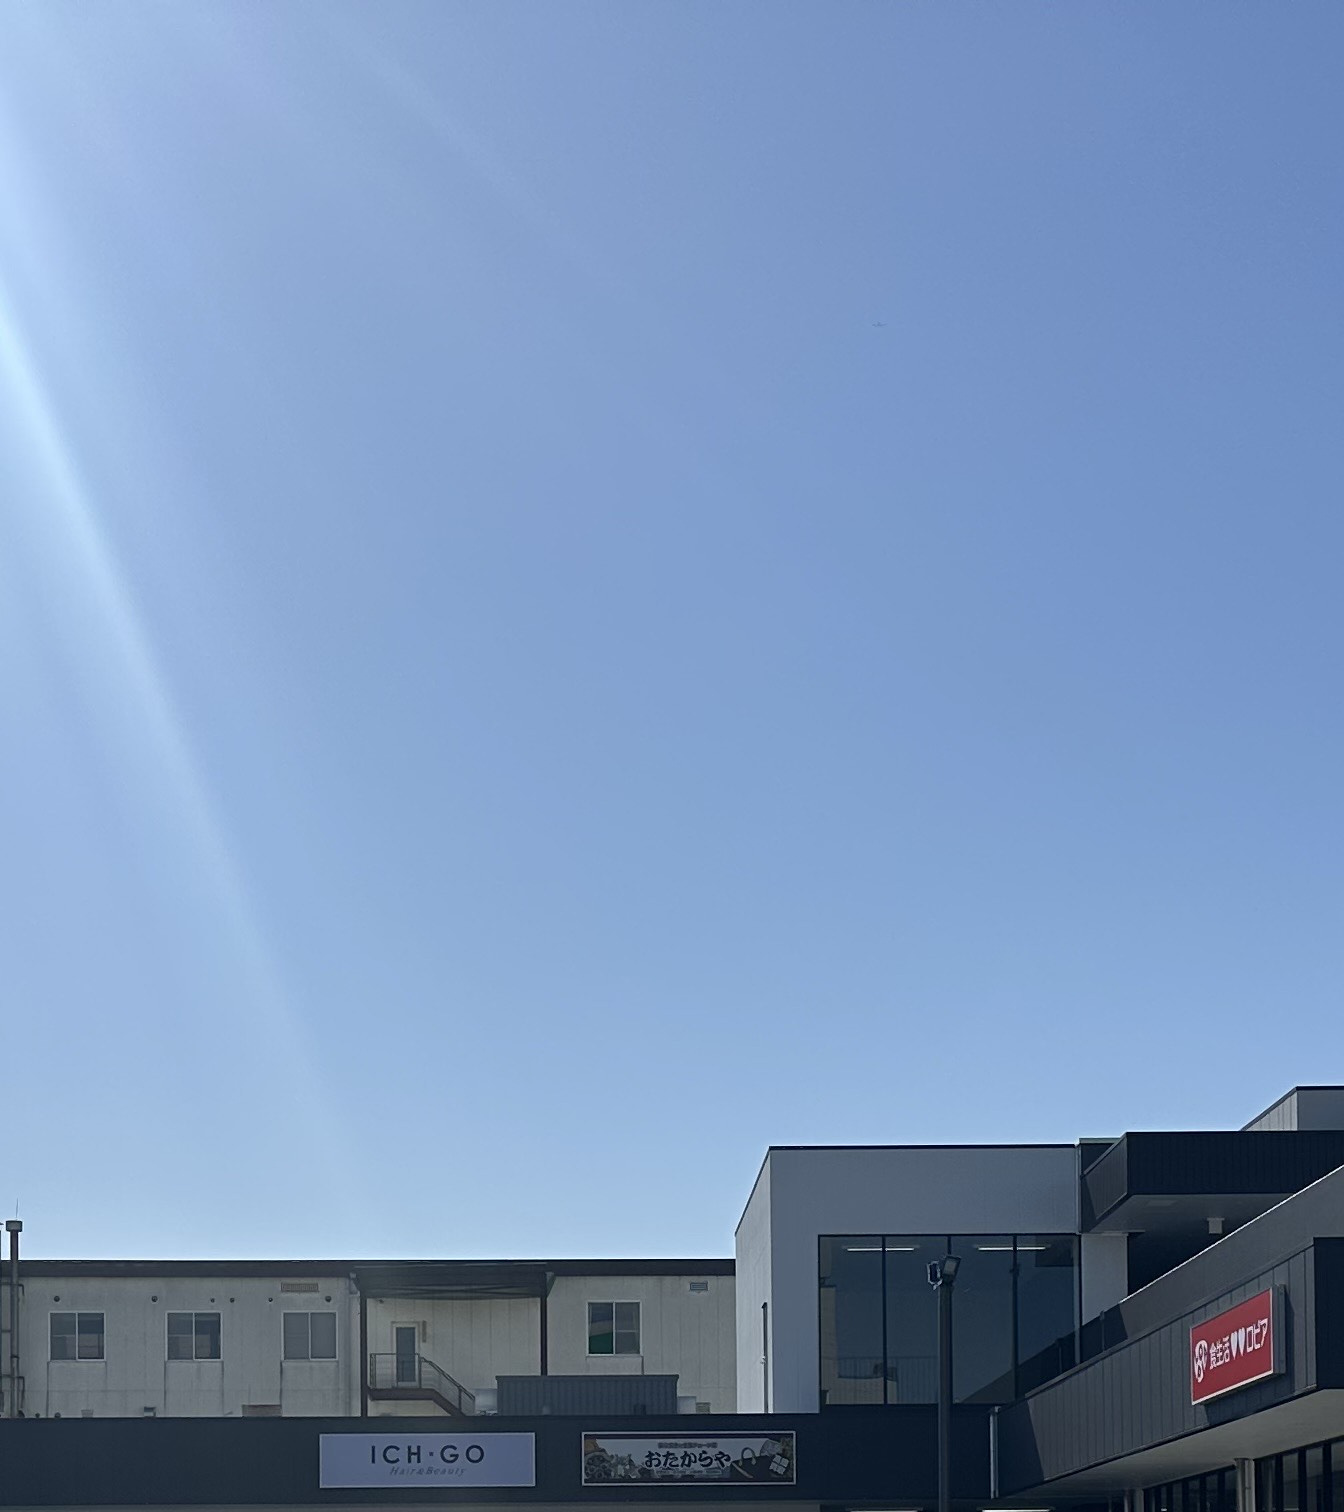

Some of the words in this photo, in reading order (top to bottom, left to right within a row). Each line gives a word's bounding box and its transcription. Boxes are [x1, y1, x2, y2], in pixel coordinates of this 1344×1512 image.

[1209, 1335, 1231, 1370] 食生活
[1246, 1318, 1268, 1353] ロピア
[644, 1450, 732, 1468] おたからや
